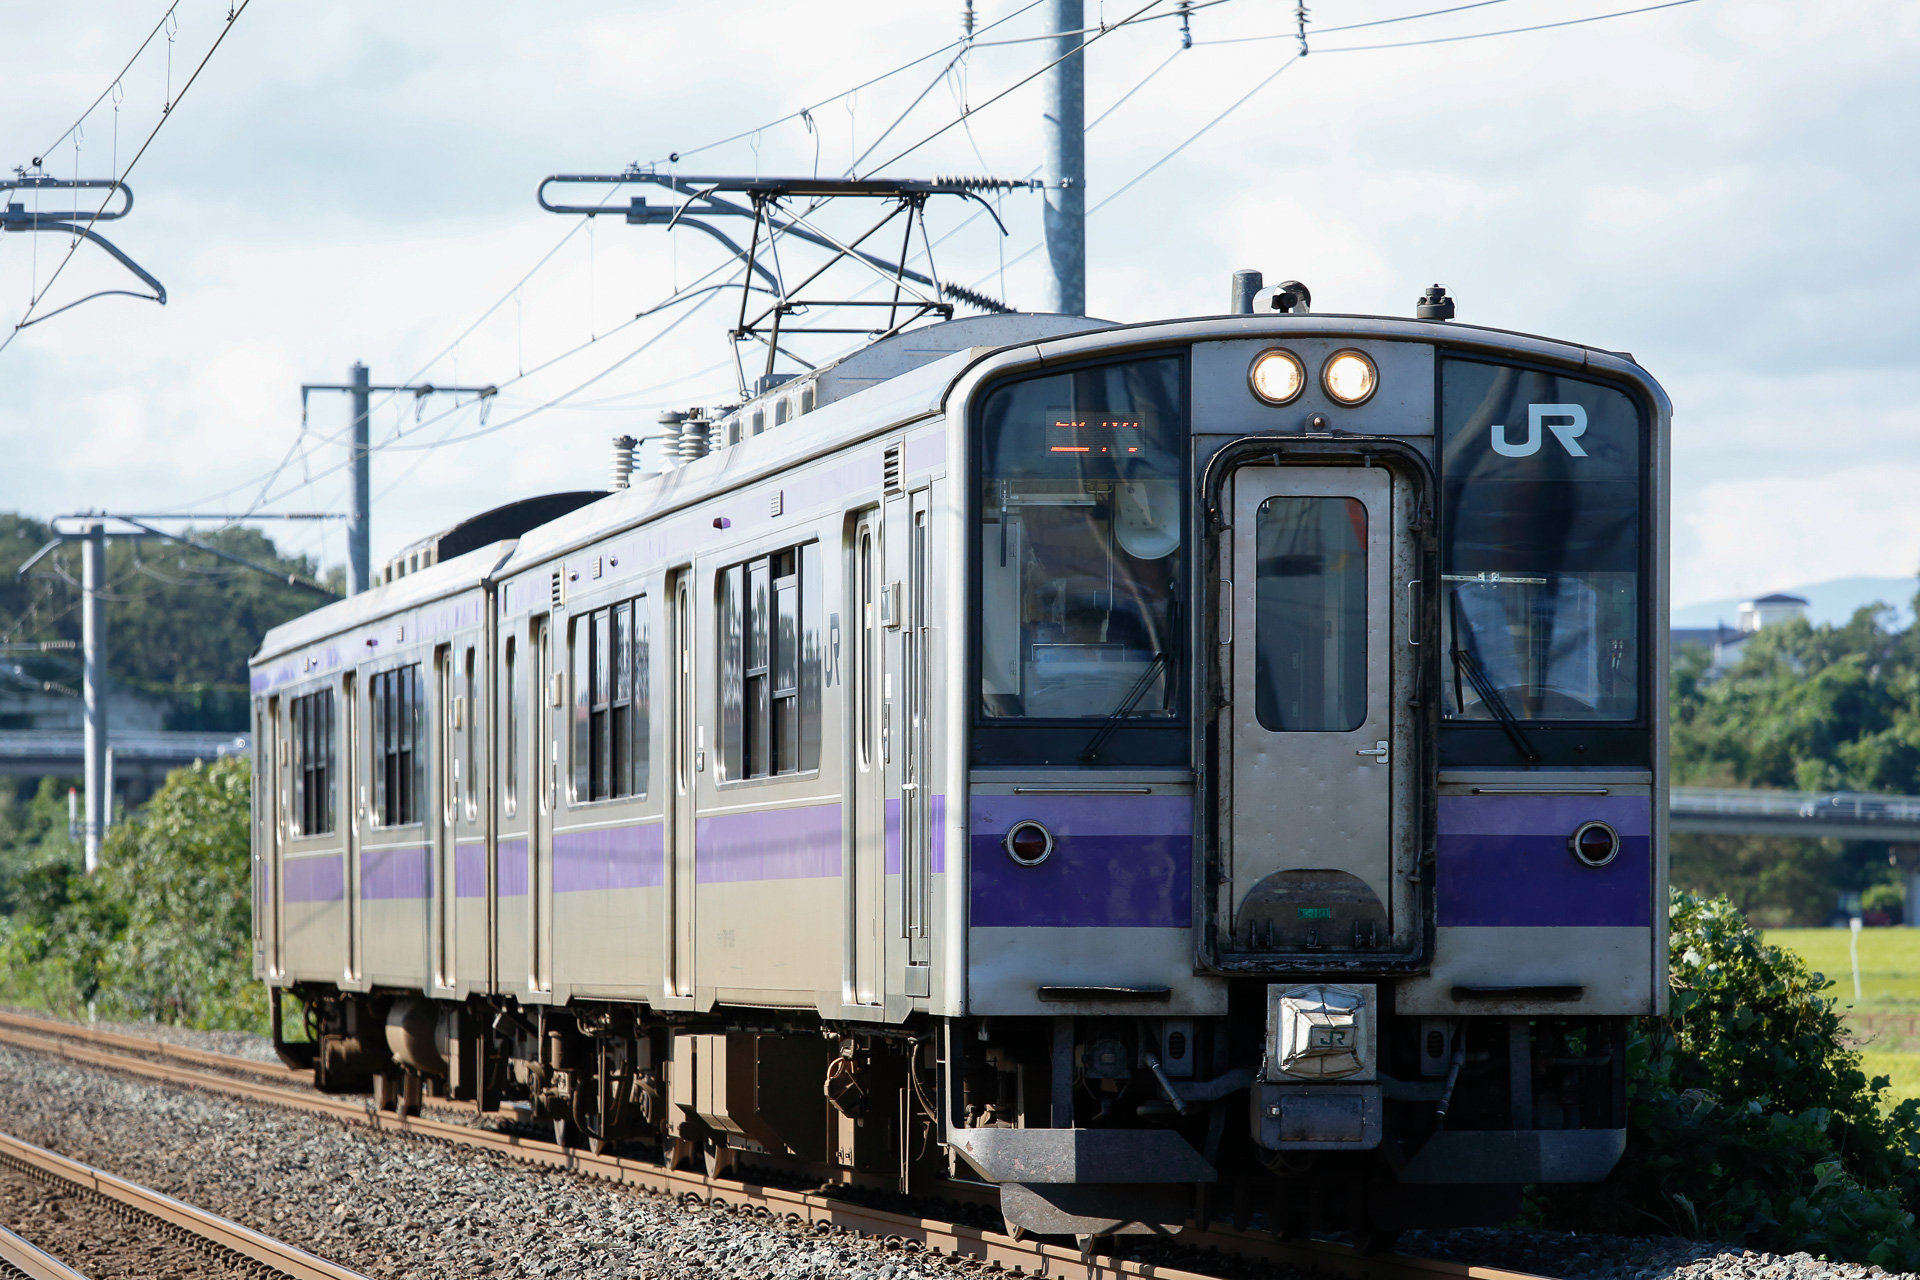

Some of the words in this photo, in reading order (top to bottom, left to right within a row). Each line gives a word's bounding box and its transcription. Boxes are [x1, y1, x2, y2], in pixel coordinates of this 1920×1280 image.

[1491, 403, 1588, 458] JR
[824, 612, 840, 688] JR
[1320, 1031, 1345, 1045] JR
